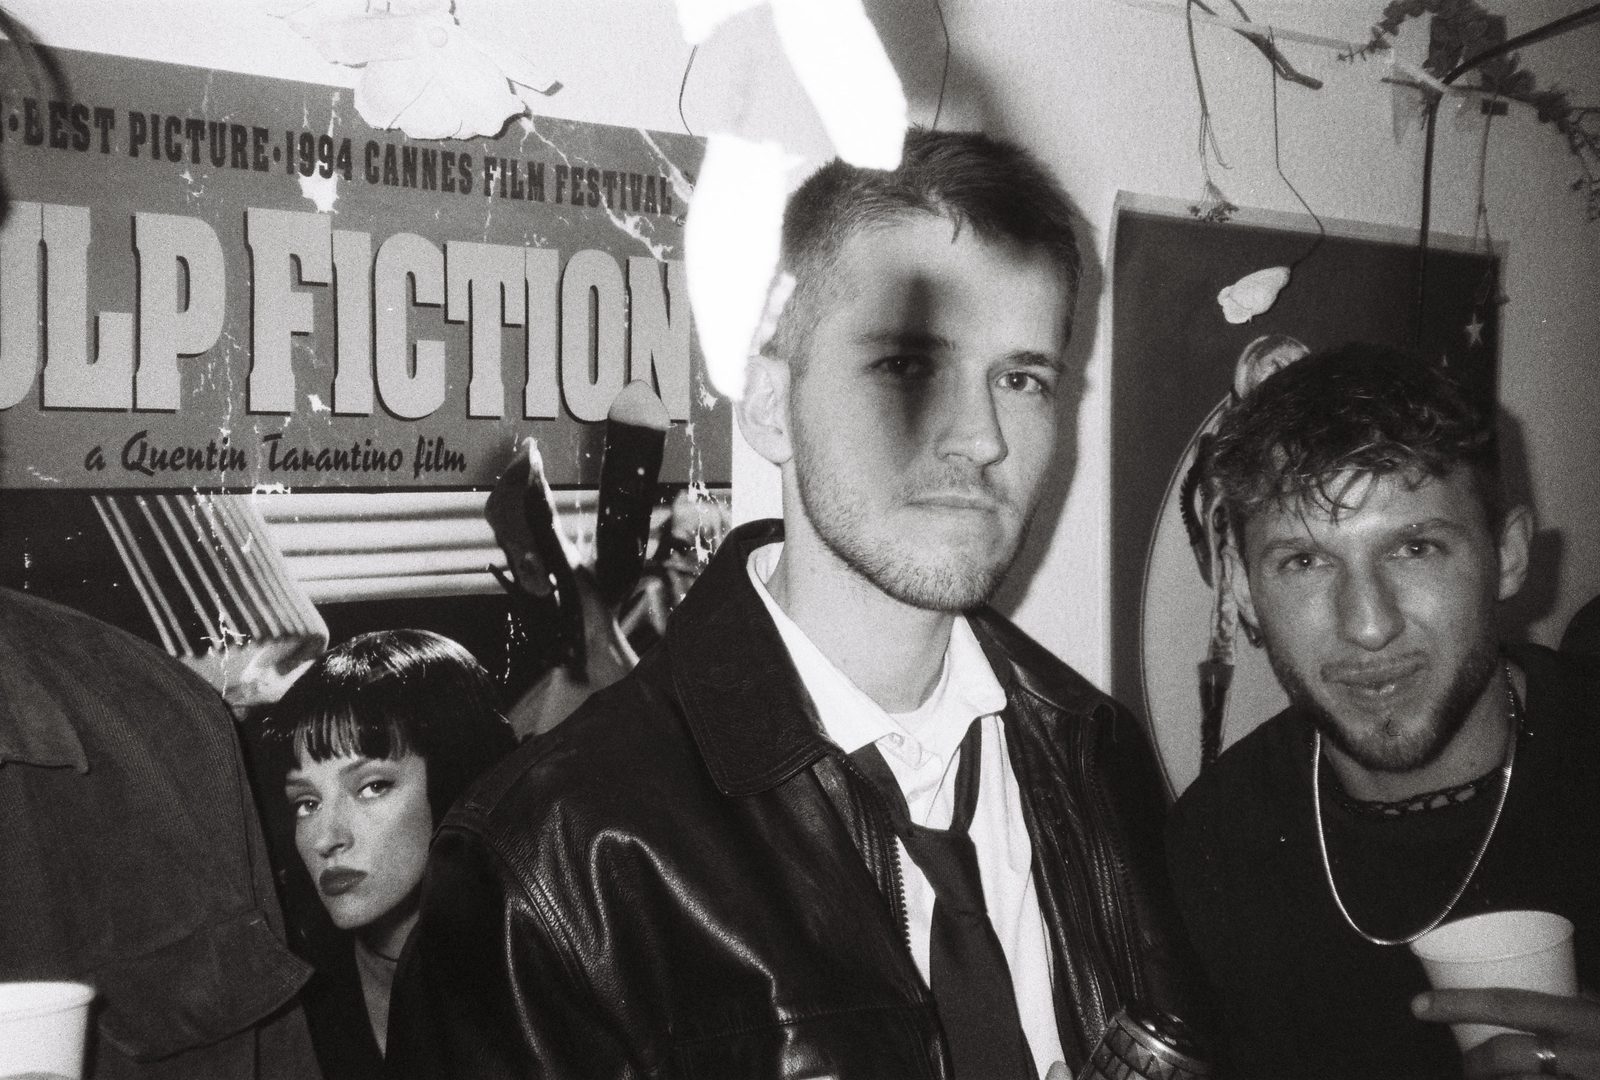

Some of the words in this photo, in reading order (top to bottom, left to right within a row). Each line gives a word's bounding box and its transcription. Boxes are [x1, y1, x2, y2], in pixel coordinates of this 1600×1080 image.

[24, 97, 115, 154] BEST
[364, 140, 473, 195] CANNES
[484, 156, 545, 202] FILM
[556, 164, 672, 215] FESTIVAL
[244, 207, 691, 423] FICTION
[84, 445, 106, 471] a
[121, 430, 247, 477] Quentin
[263, 433, 403, 472] Tarantino
[413, 434, 467, 480] film
